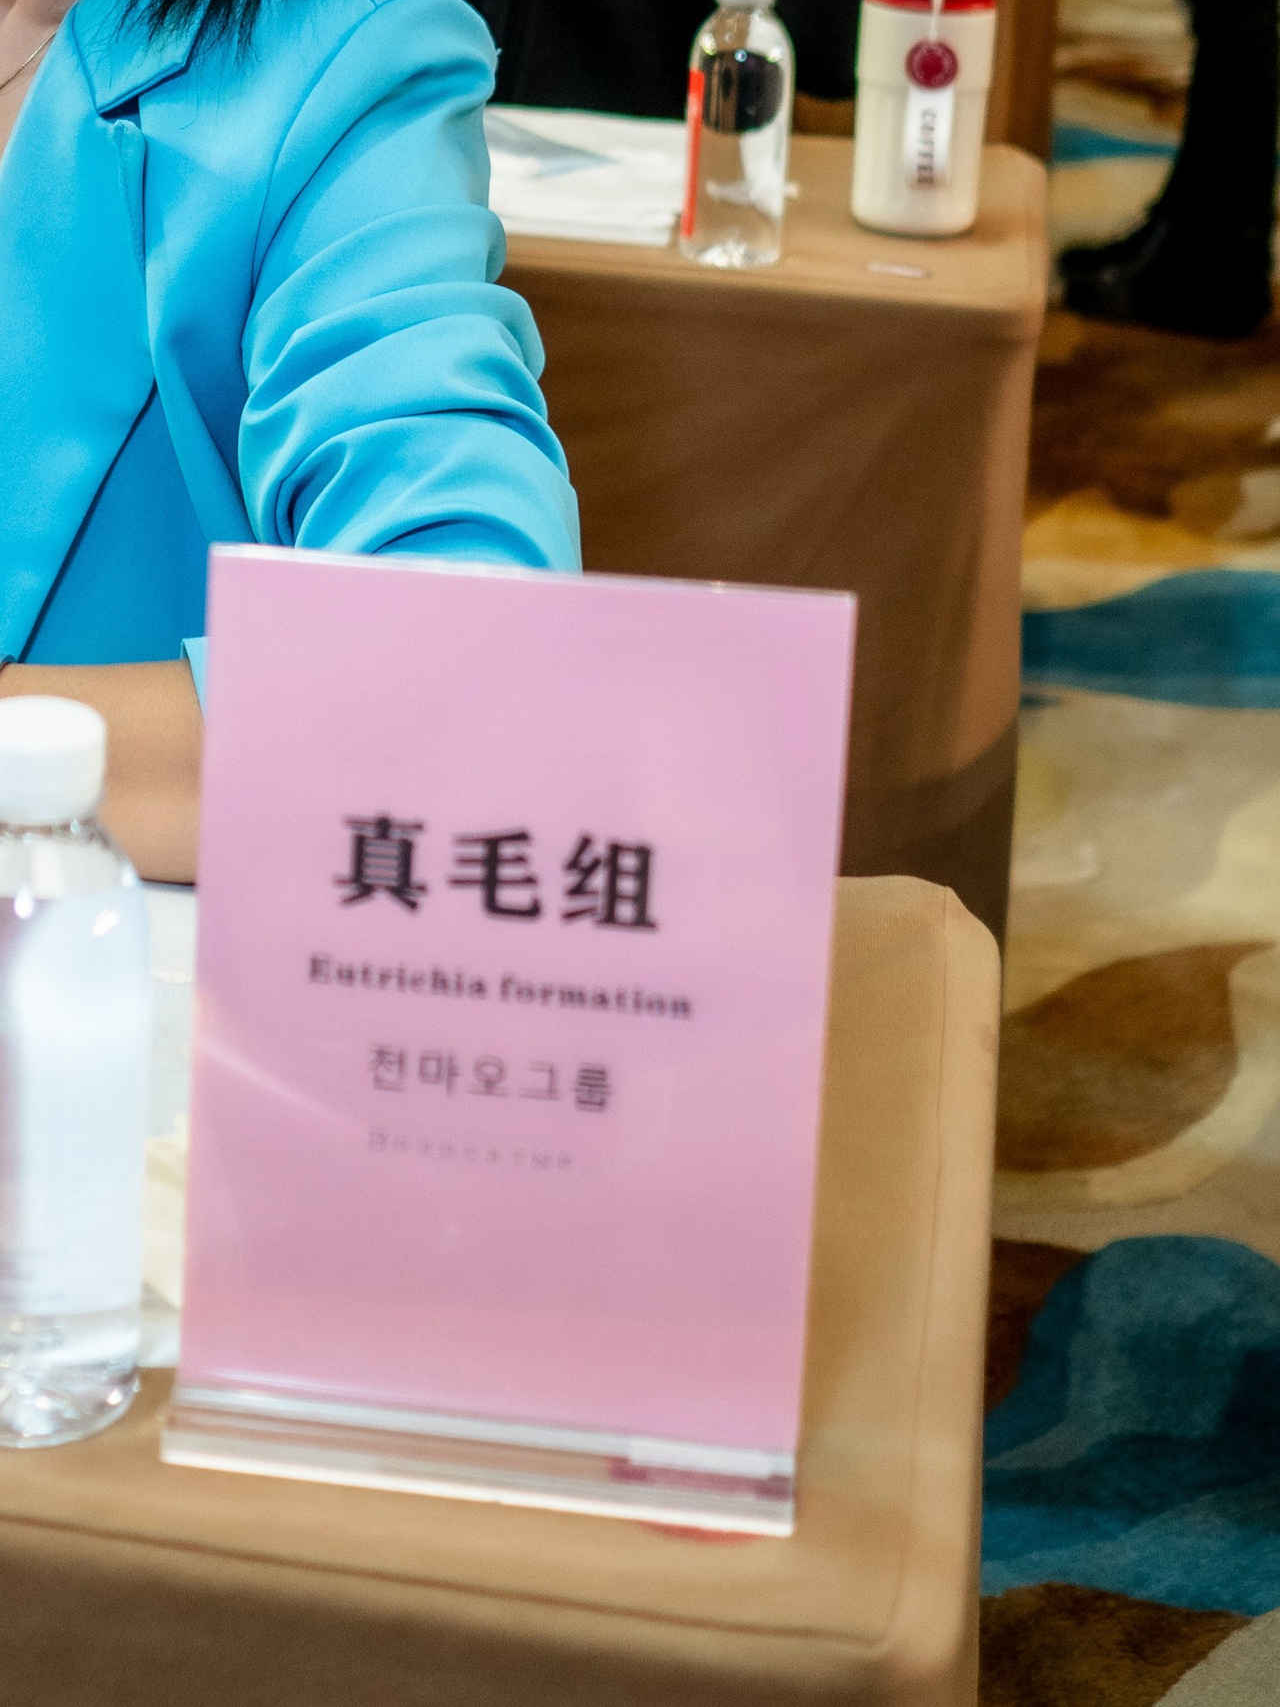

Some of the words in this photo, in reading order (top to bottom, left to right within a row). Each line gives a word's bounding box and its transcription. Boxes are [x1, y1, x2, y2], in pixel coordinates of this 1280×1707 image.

[333, 811, 659, 934] 真毛组
[308, 950, 488, 1001] Eutrichia
[499, 972, 694, 1020] formation
